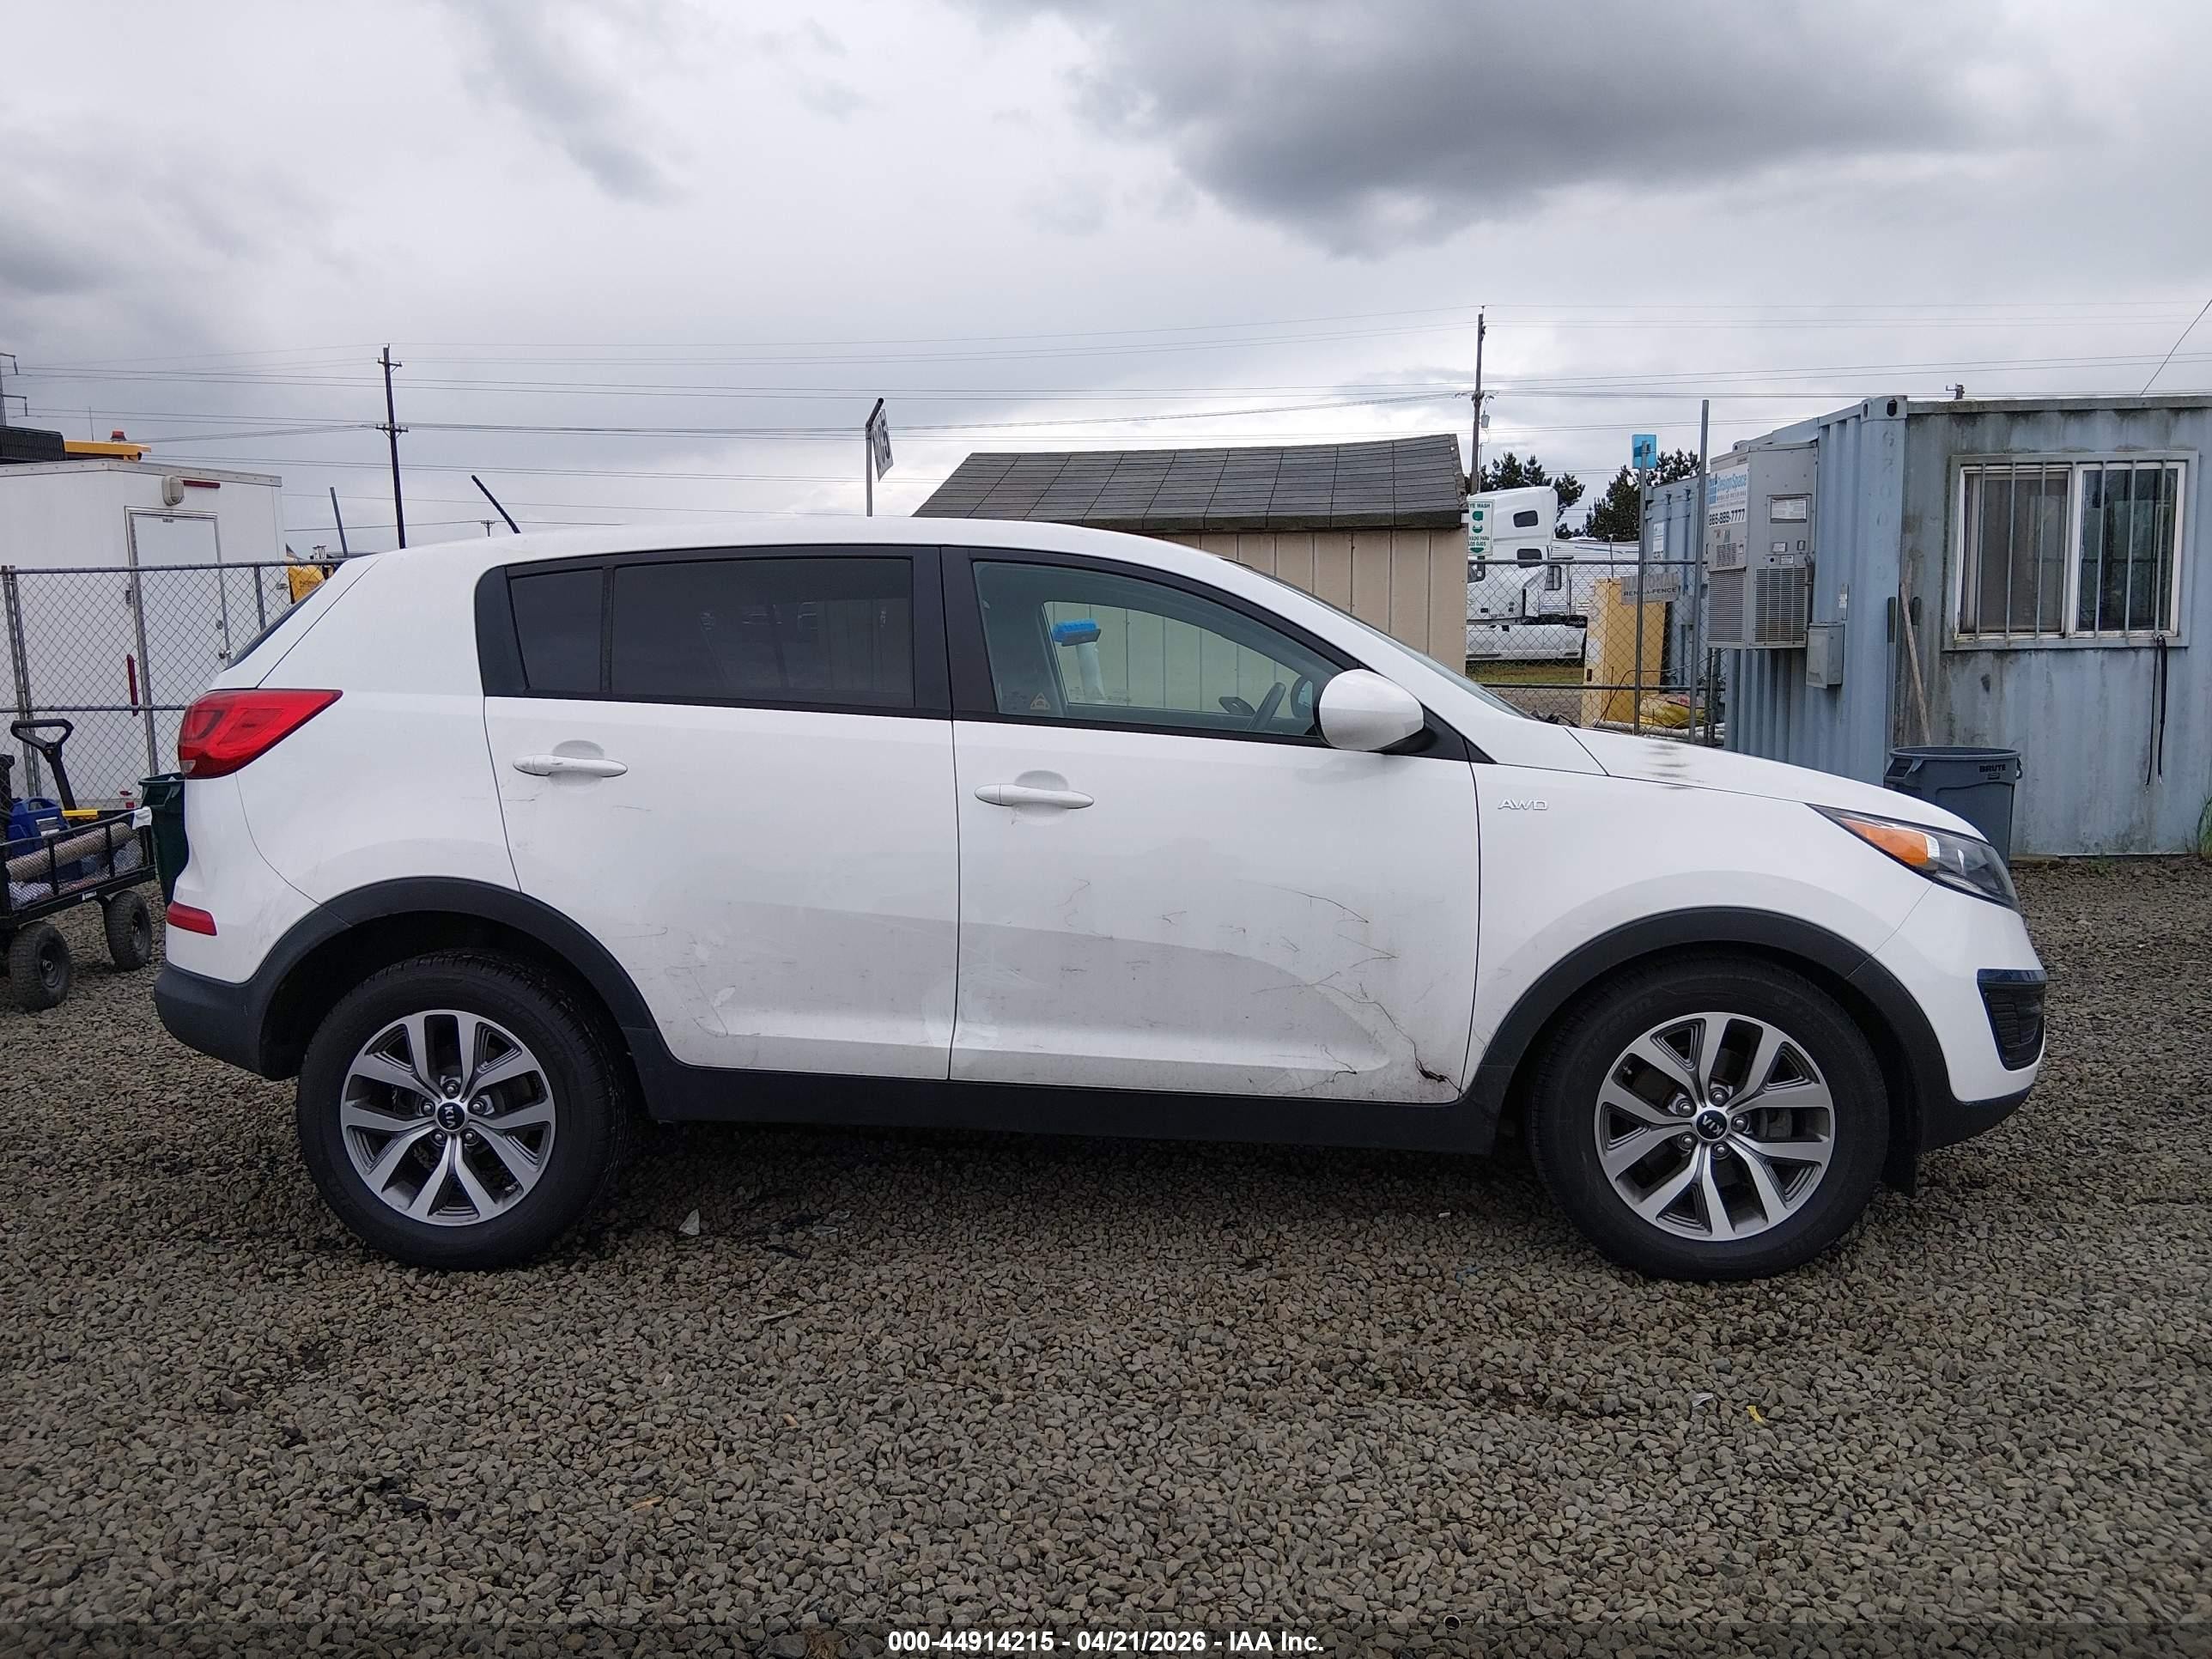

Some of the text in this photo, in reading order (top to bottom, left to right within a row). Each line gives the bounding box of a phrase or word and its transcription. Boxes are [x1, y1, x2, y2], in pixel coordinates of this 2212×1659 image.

[1979, 763, 2007, 772] BRUTE
[1497, 799, 1548, 811] AWD
[445, 1105, 455, 1128] KIA
[1702, 1115, 1723, 1135] KIA
